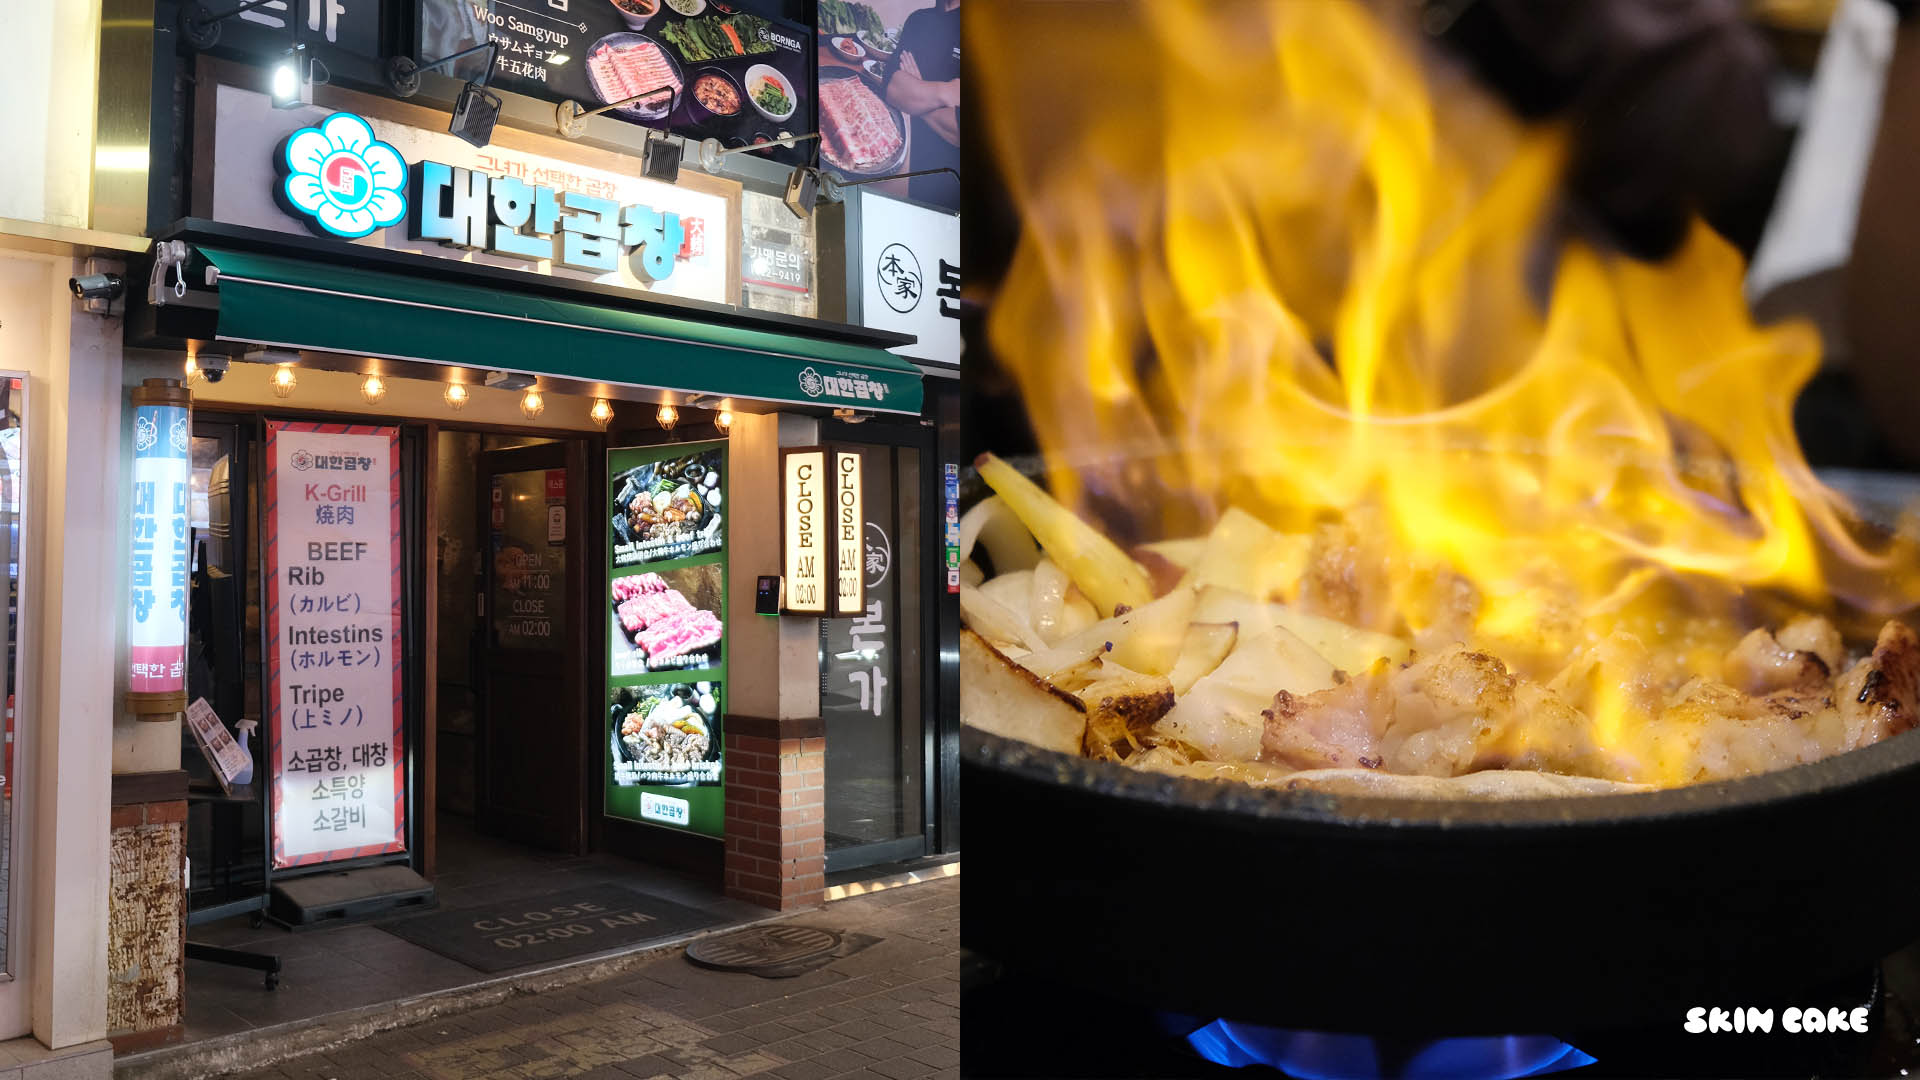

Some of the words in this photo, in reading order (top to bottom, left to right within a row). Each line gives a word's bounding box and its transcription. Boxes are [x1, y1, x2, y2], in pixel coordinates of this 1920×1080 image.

[474, 5, 504, 26] Woo
[508, 15, 569, 48] Samgyup
[770, 32, 801, 50] BORNGA
[496, 55, 547, 82] 牛五花肉
[475, 154, 528, 177] 그녀가
[585, 176, 617, 199] 곱창
[420, 159, 685, 281] 대한곱창
[882, 254, 918, 299] 本家
[823, 375, 884, 401] 대한곱창
[315, 455, 372, 472] 대한곱창
[304, 483, 367, 503] K-Grill
[840, 456, 855, 541] CLOSE
[315, 504, 355, 525] 焼肉
[797, 464, 814, 548] CLOSE
[307, 541, 369, 561] BEEF
[839, 548, 857, 571] AM
[288, 566, 325, 586] Rib
[796, 555, 815, 578] AM
[795, 583, 816, 604] 02:00
[838, 577, 858, 597] 02:00
[290, 593, 361, 616] (カルビ)
[513, 600, 545, 613] CLOSE
[288, 625, 384, 645] Intestins
[522, 621, 551, 637] 02:00
[290, 646, 381, 671] (ホルモン)
[289, 684, 345, 708] Tripe
[291, 705, 364, 731] (上ミノ)
[287, 745, 348, 773] 소곱창,
[352, 742, 388, 768] 대창
[311, 773, 367, 801] 소특양
[312, 804, 367, 832] 소갈비
[473, 902, 607, 932] CLOSE
[494, 924, 595, 949] 02:00
[601, 911, 657, 929] AM
